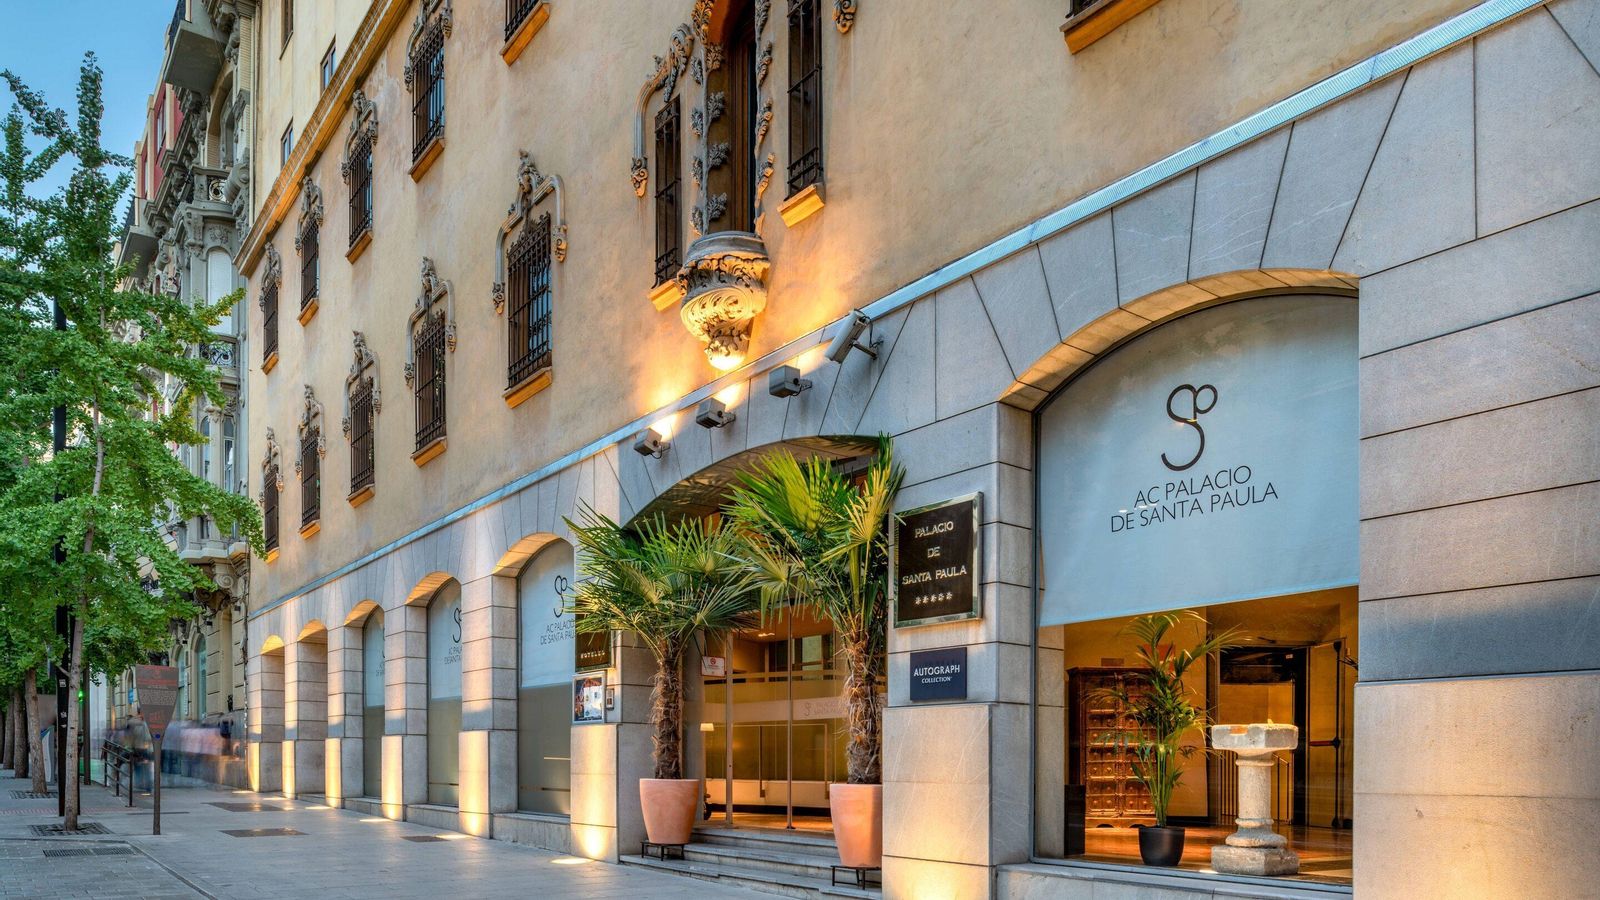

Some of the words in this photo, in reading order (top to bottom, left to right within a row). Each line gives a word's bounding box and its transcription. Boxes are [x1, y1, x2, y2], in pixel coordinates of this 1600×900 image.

[1134, 486, 1160, 508] AC
[1165, 465, 1252, 500] PALACIO
[1111, 512, 1135, 533] DE
[1140, 498, 1204, 527] SANTA
[1211, 482, 1279, 512] PAULA
[914, 521, 954, 538] PALACIO
[927, 546, 940, 558] DE
[902, 572, 932, 585] SANTA
[935, 565, 967, 580] PAULA
[913, 664, 961, 677] AUTOGRAPH
[921, 676, 952, 684] COLLECTION
